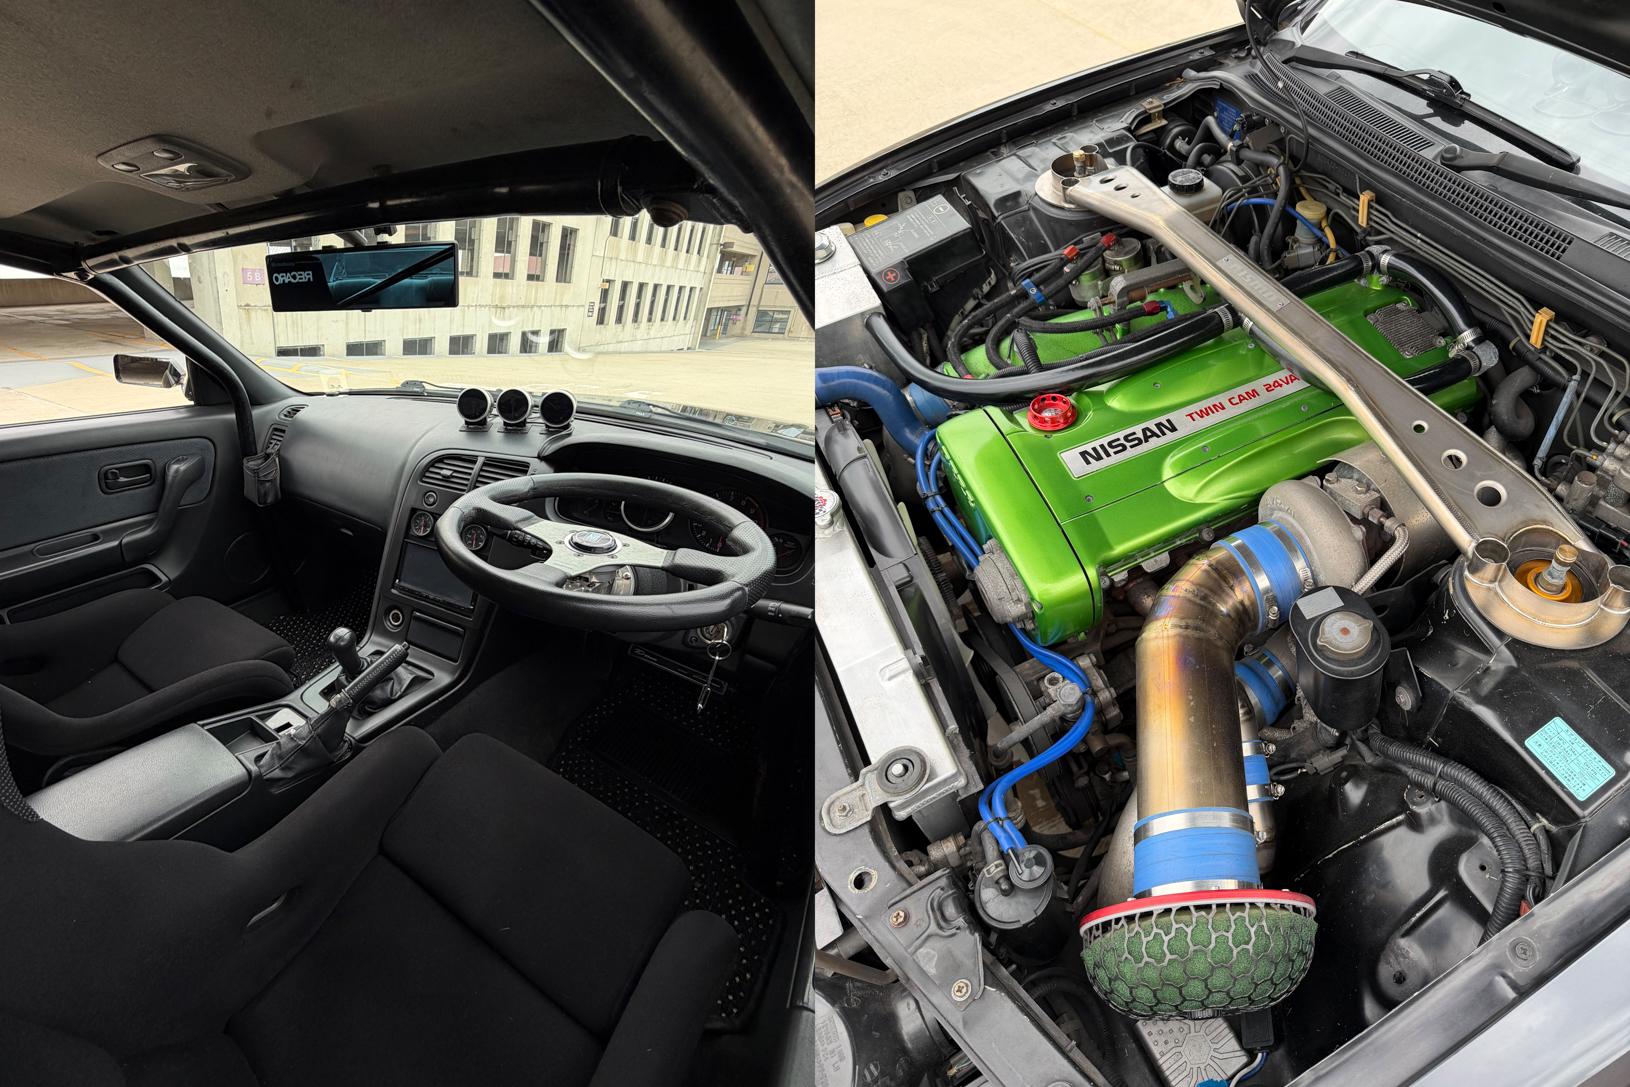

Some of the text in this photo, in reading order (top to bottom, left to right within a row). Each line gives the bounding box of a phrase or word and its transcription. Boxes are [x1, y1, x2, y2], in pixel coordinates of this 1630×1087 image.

[1078, 373, 1300, 466] NISSAN TWIN CAM 24VA
